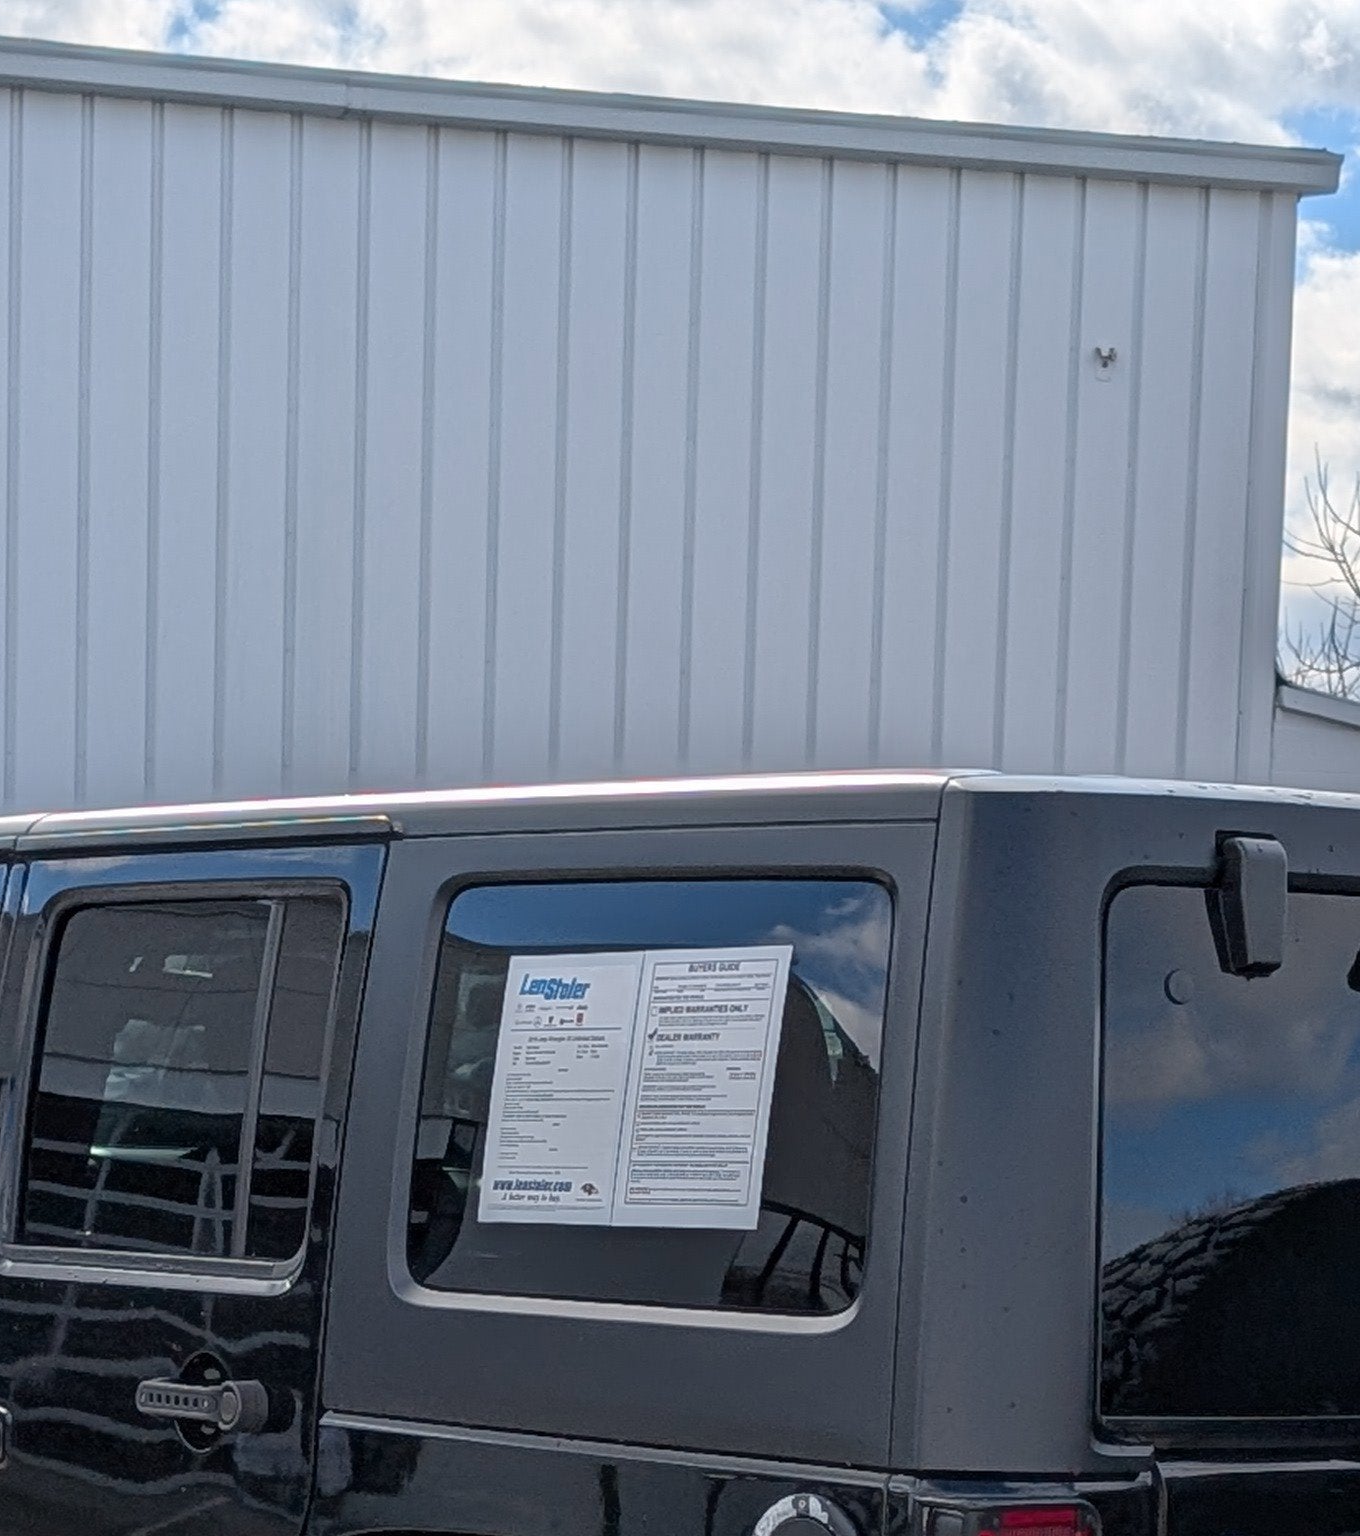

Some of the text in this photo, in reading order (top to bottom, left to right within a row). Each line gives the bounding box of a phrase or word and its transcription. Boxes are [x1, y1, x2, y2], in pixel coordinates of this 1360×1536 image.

[688, 961, 741, 973] BUYERS GUIDE
[658, 1003, 749, 1015] IMPLIED WARRANTIES ONLY
[656, 1032, 721, 1042] DEALER WARRANTY
[492, 1179, 573, 1192] www.lenstoler.com
